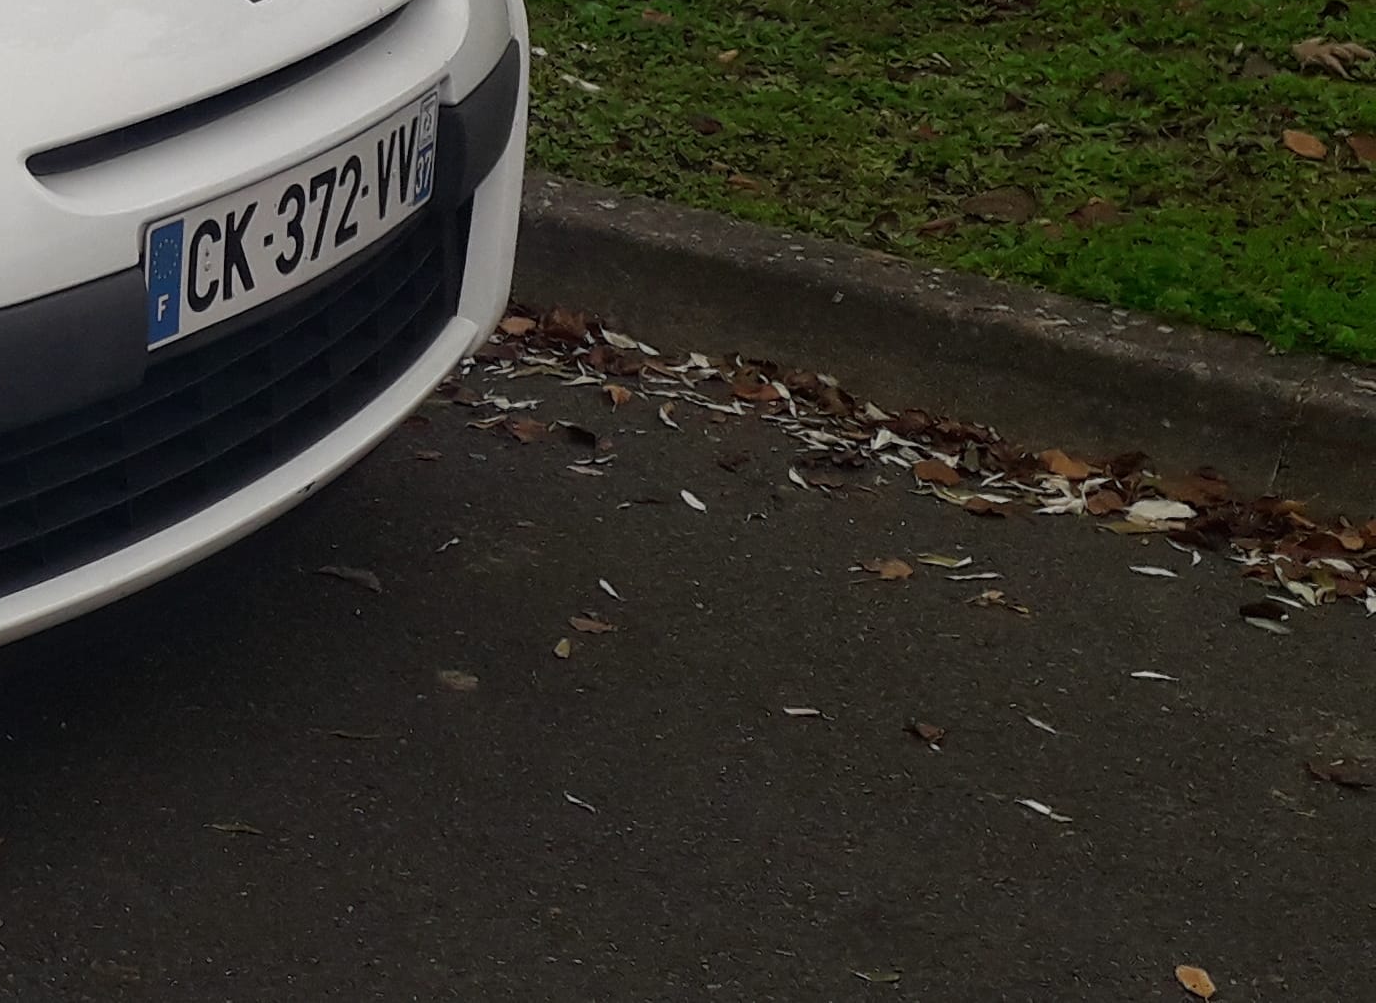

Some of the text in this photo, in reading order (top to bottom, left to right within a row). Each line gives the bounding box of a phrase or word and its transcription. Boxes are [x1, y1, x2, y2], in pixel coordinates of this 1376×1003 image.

[415, 148, 433, 195] 37
[186, 116, 418, 313] CK-372-VV
[156, 294, 169, 322] F
